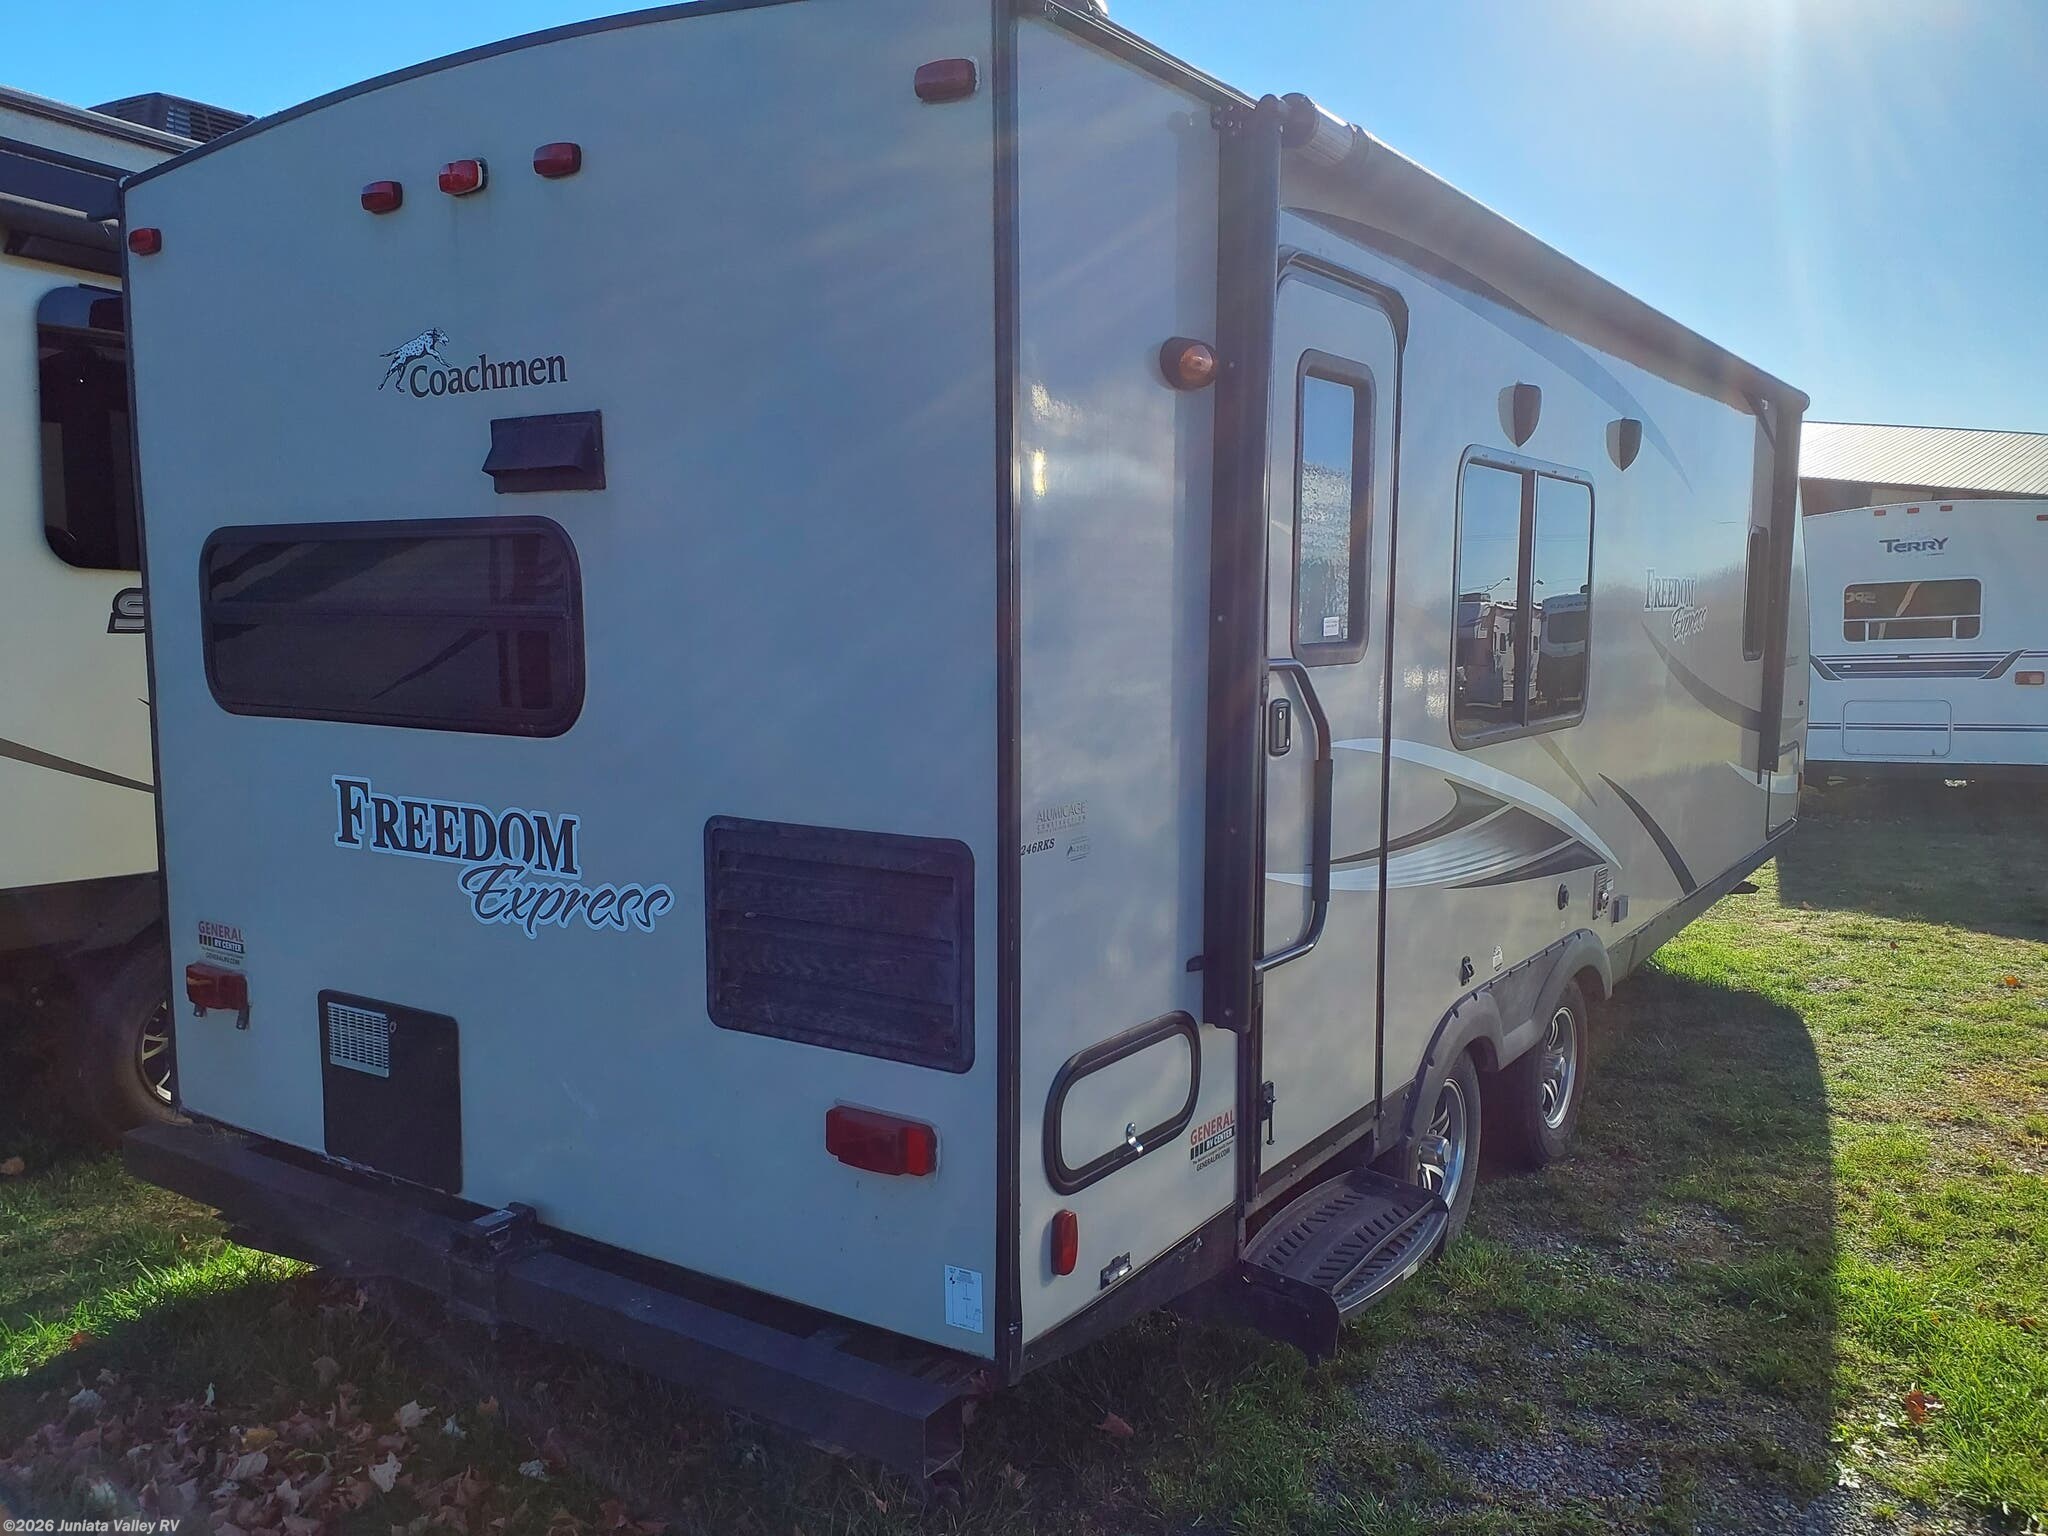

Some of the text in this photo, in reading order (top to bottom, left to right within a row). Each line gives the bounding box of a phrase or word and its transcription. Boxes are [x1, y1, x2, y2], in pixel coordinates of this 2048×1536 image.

[410, 353, 568, 398] Coachmen
[1879, 537, 1949, 553] TERRY
[1644, 568, 1696, 610] FREEDOM
[333, 776, 580, 876] FREEDOM
[1020, 838, 1056, 856] 246RKS
[461, 861, 673, 934] Express
[199, 920, 244, 942] GENERAL
[1191, 1110, 1234, 1146] GENERAL
